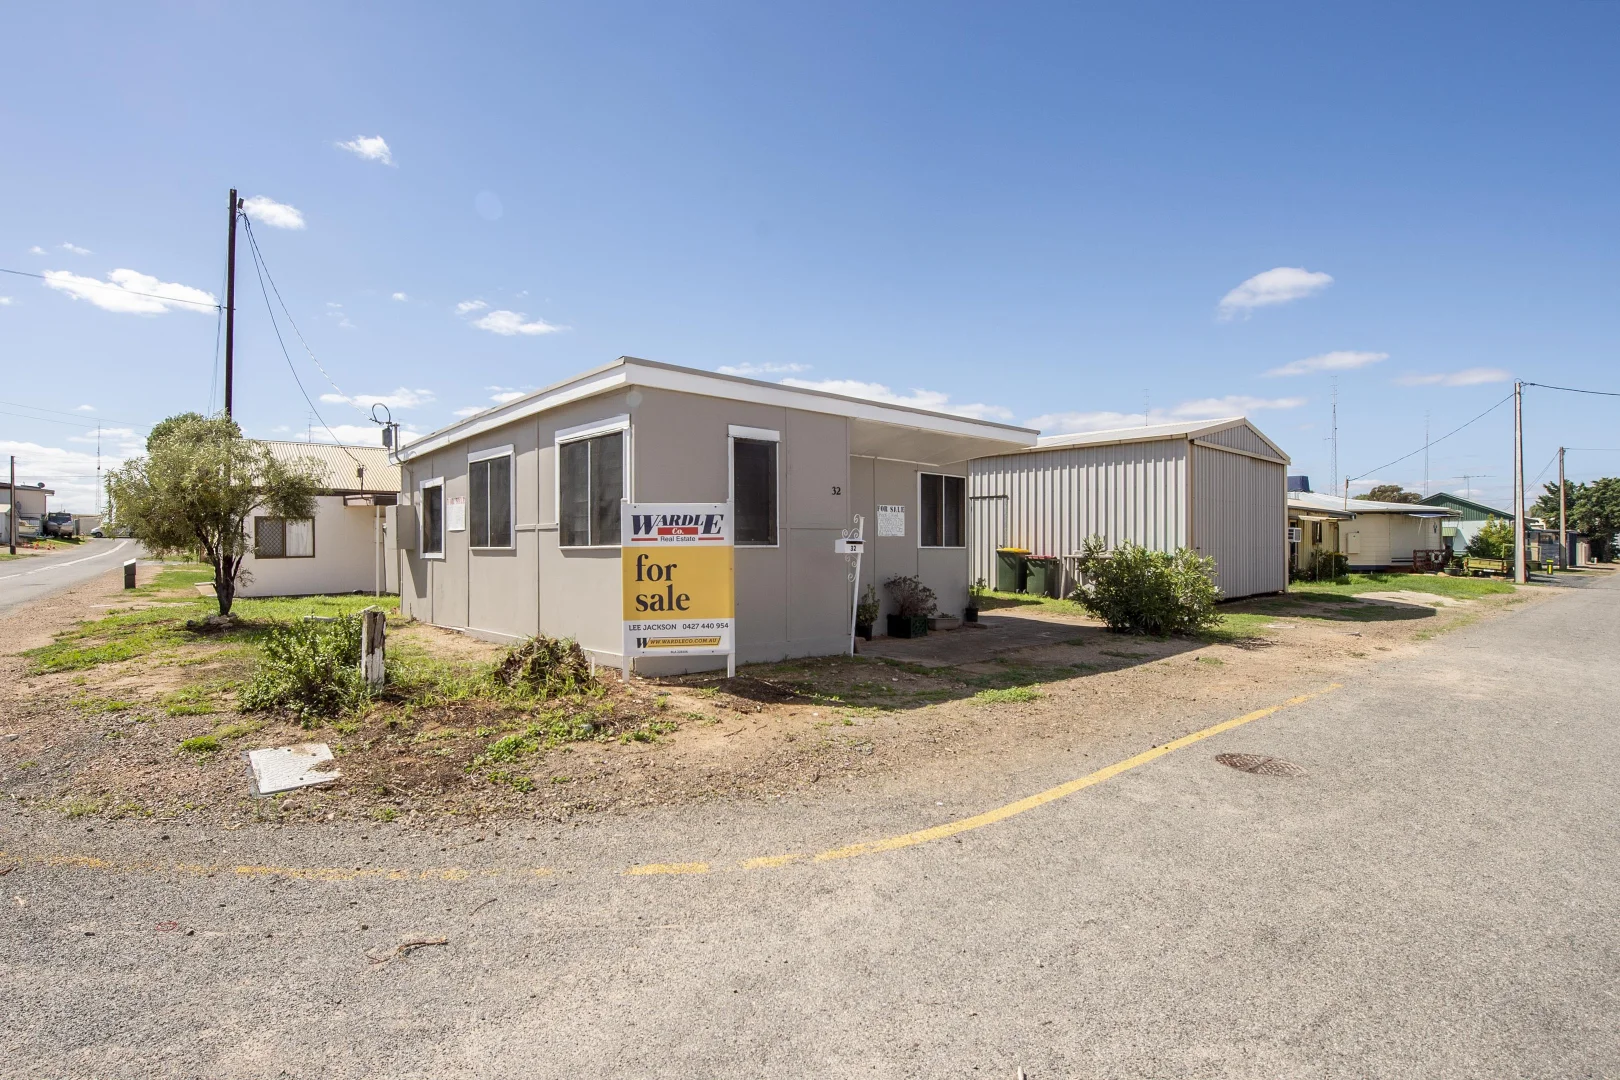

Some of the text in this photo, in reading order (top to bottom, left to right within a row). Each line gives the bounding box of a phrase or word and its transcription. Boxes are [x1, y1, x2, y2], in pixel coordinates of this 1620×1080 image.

[832, 486, 841, 495] 32
[631, 514, 724, 535] WARDLE
[635, 554, 677, 581] for
[635, 584, 690, 612] sale
